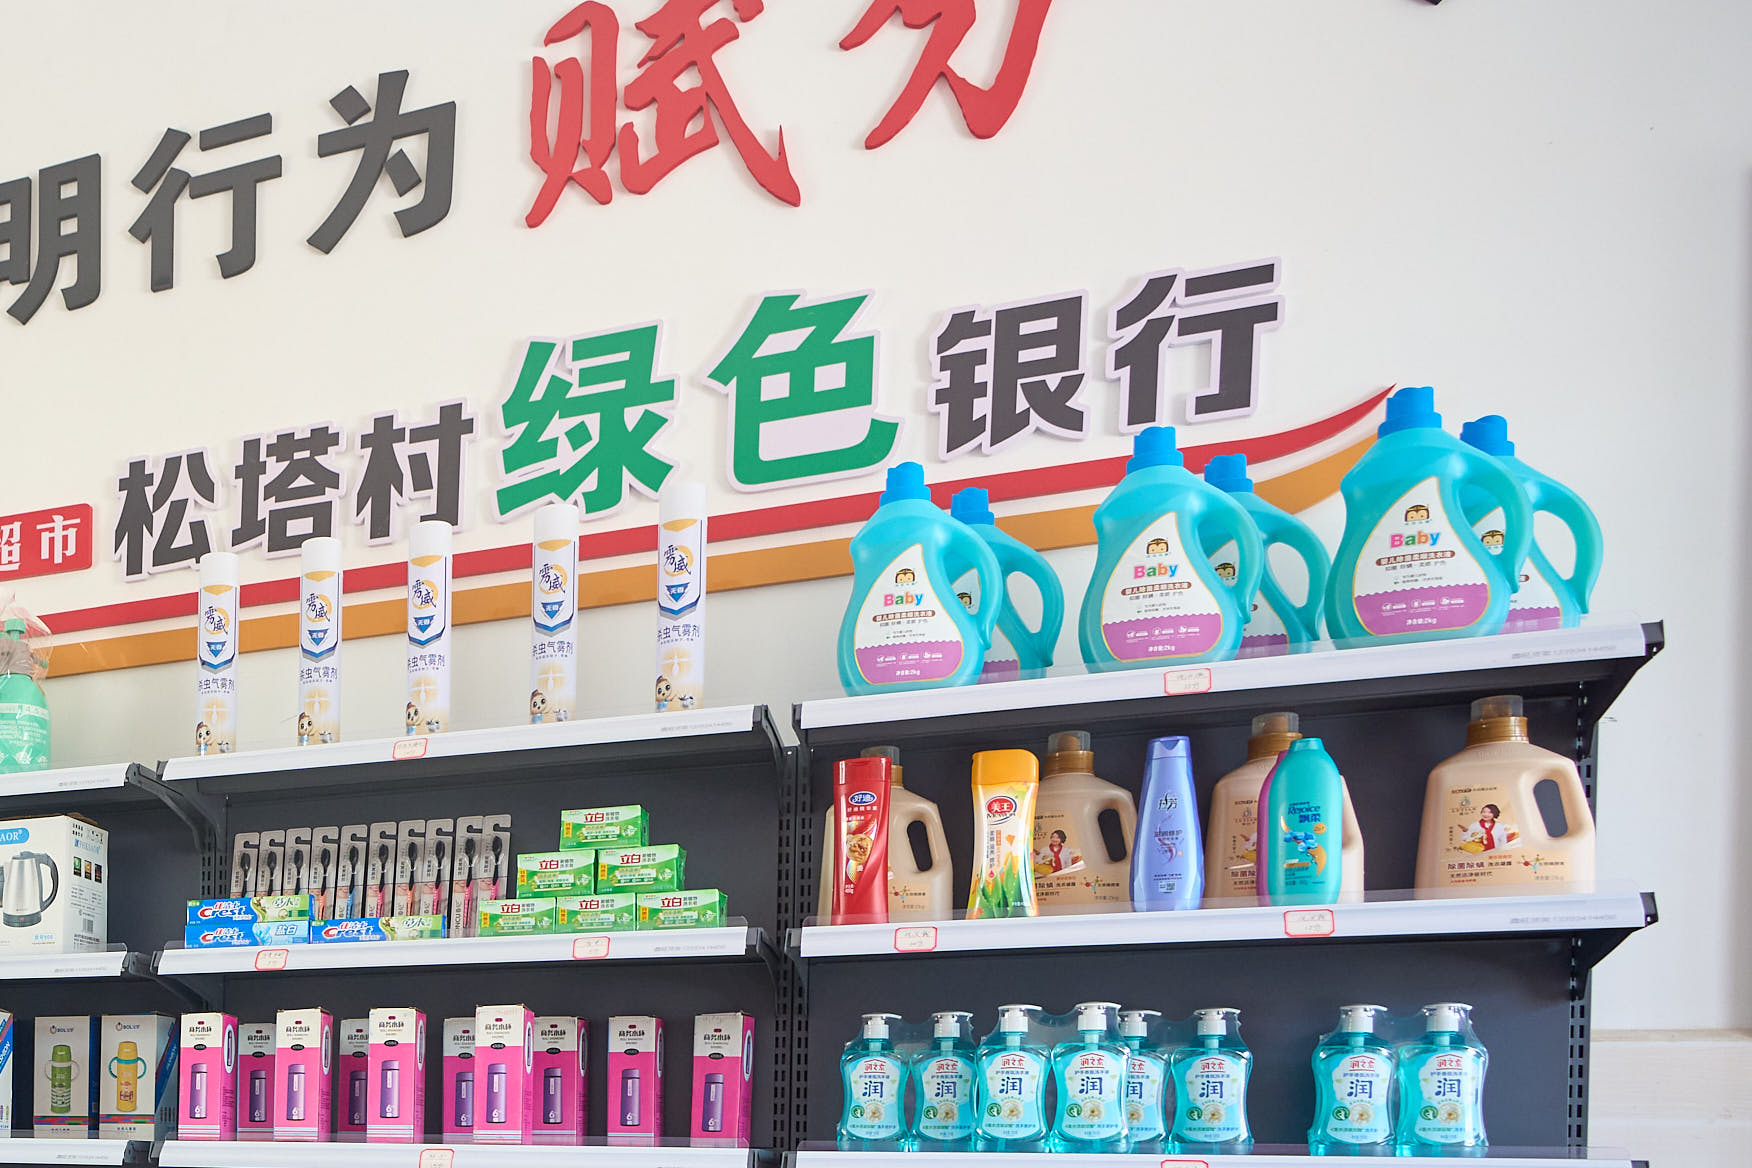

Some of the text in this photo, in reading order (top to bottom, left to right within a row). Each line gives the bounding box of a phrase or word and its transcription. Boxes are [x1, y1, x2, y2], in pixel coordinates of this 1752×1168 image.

[1390, 530, 1441, 548] Baby
[1133, 563, 1179, 580] Baby
[883, 592, 924, 607] Baby
[583, 811, 605, 823] 立白
[1288, 805, 1321, 816] Rejoice
[1298, 812, 1321, 823] 飘柔
[539, 859, 560, 870] 立白
[620, 853, 641, 865] 立白
[214, 900, 240, 910] 佳洁士
[500, 903, 521, 914] 立白
[579, 899, 599, 910] 立白
[661, 897, 682, 908] 立白
[199, 904, 246, 919] Crest
[216, 926, 240, 936] 佳洁士
[323, 925, 372, 938] Crest
[339, 920, 368, 931] 佳洁士
[200, 930, 244, 944] Crest
[862, 1079, 884, 1099] 润
[934, 1078, 957, 1099] 润
[998, 1075, 1024, 1096] 润
[1079, 1076, 1103, 1097] 润
[1199, 1079, 1224, 1100] 润
[1347, 1079, 1373, 1098] 润
[1435, 1078, 1462, 1098] 润
